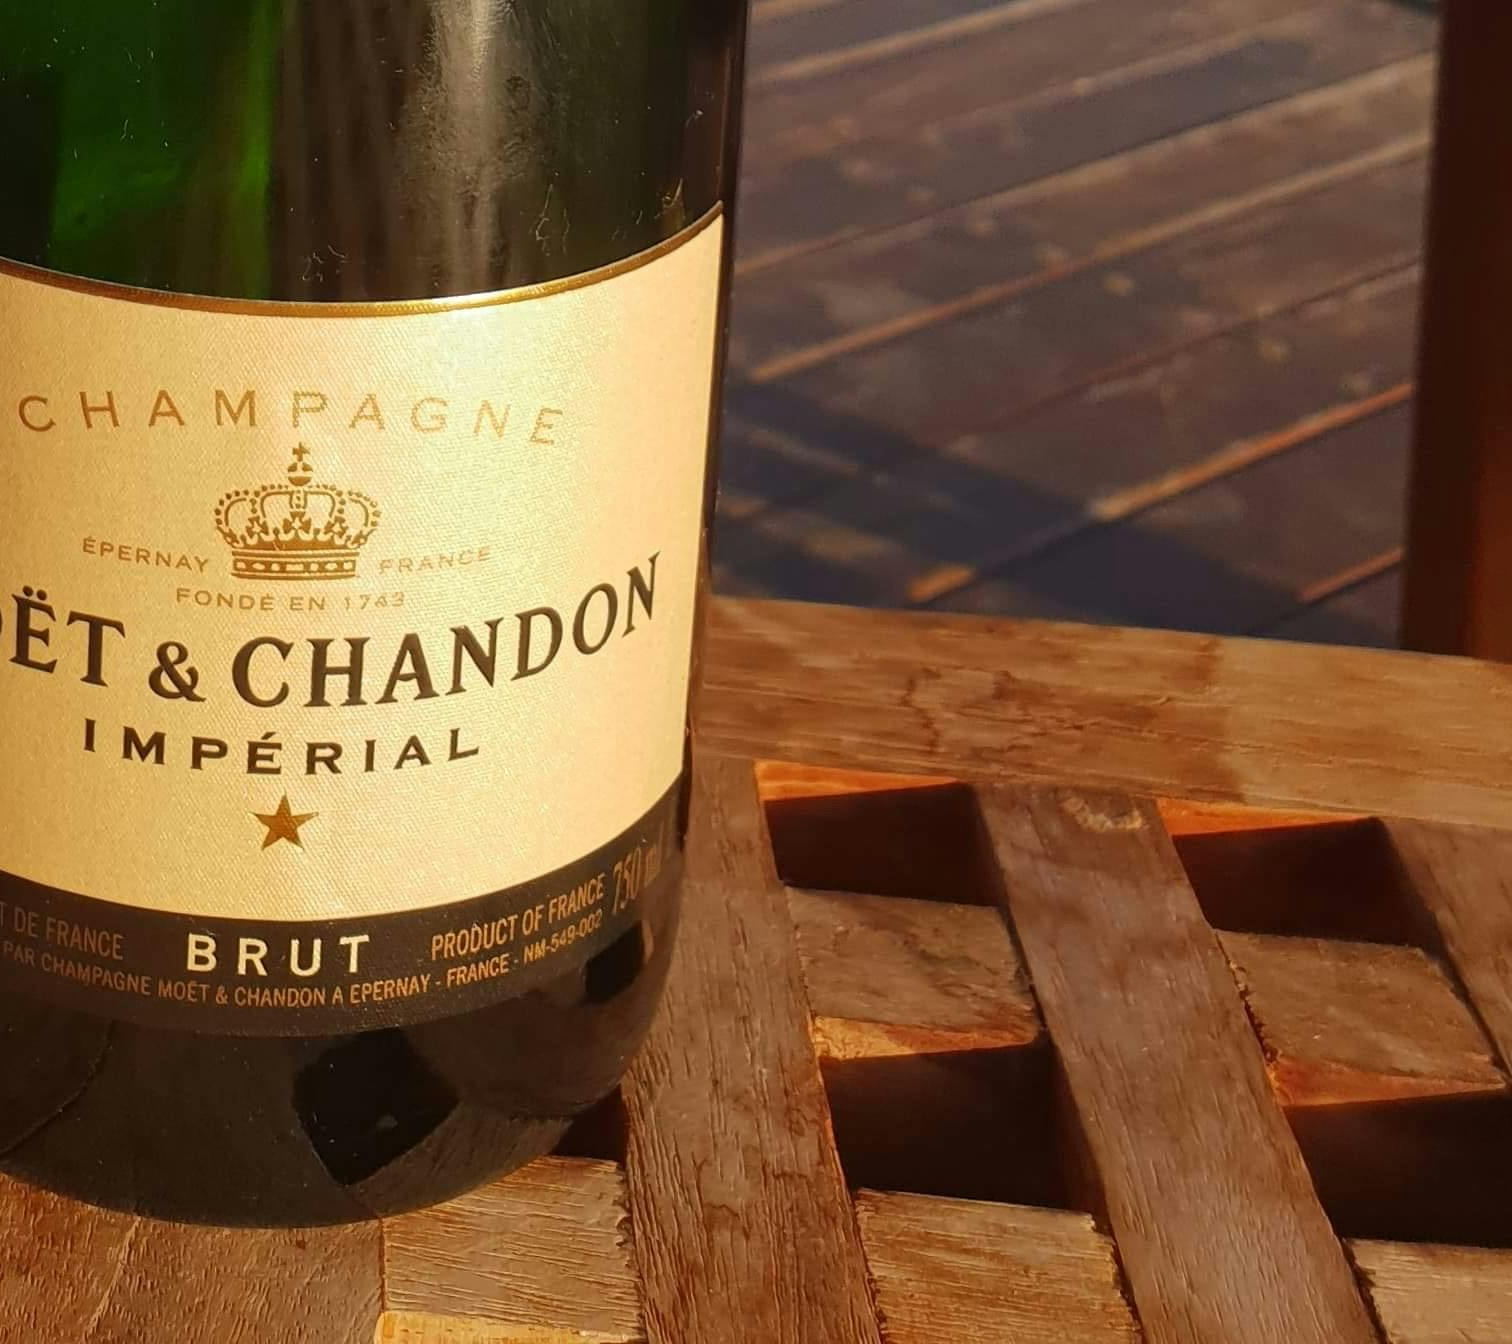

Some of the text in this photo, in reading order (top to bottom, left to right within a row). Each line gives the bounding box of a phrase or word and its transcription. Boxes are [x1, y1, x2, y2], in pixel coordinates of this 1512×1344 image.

[18, 389, 563, 445] CHAMPAGNE
[82, 536, 490, 574] ÉPERNAY FRANCE
[176, 588, 275, 611] FONDÉ
[289, 595, 325, 611] EN
[148, 640, 207, 702] &
[231, 550, 661, 708] CHANDON
[84, 718, 480, 776] IMPÉRIAL
[611, 846, 642, 915] 750
[14, 907, 39, 938] DE
[46, 916, 124, 960] FRANCE
[431, 872, 606, 961] PRODUCT OF FRANCE
[3, 941, 37, 967] PAR
[41, 953, 152, 995] CHAMPAGNE
[215, 985, 229, 1005] &
[234, 986, 326, 1007] CHANDON
[447, 953, 510, 989] FRANCE
[187, 933, 369, 976] BRUT
